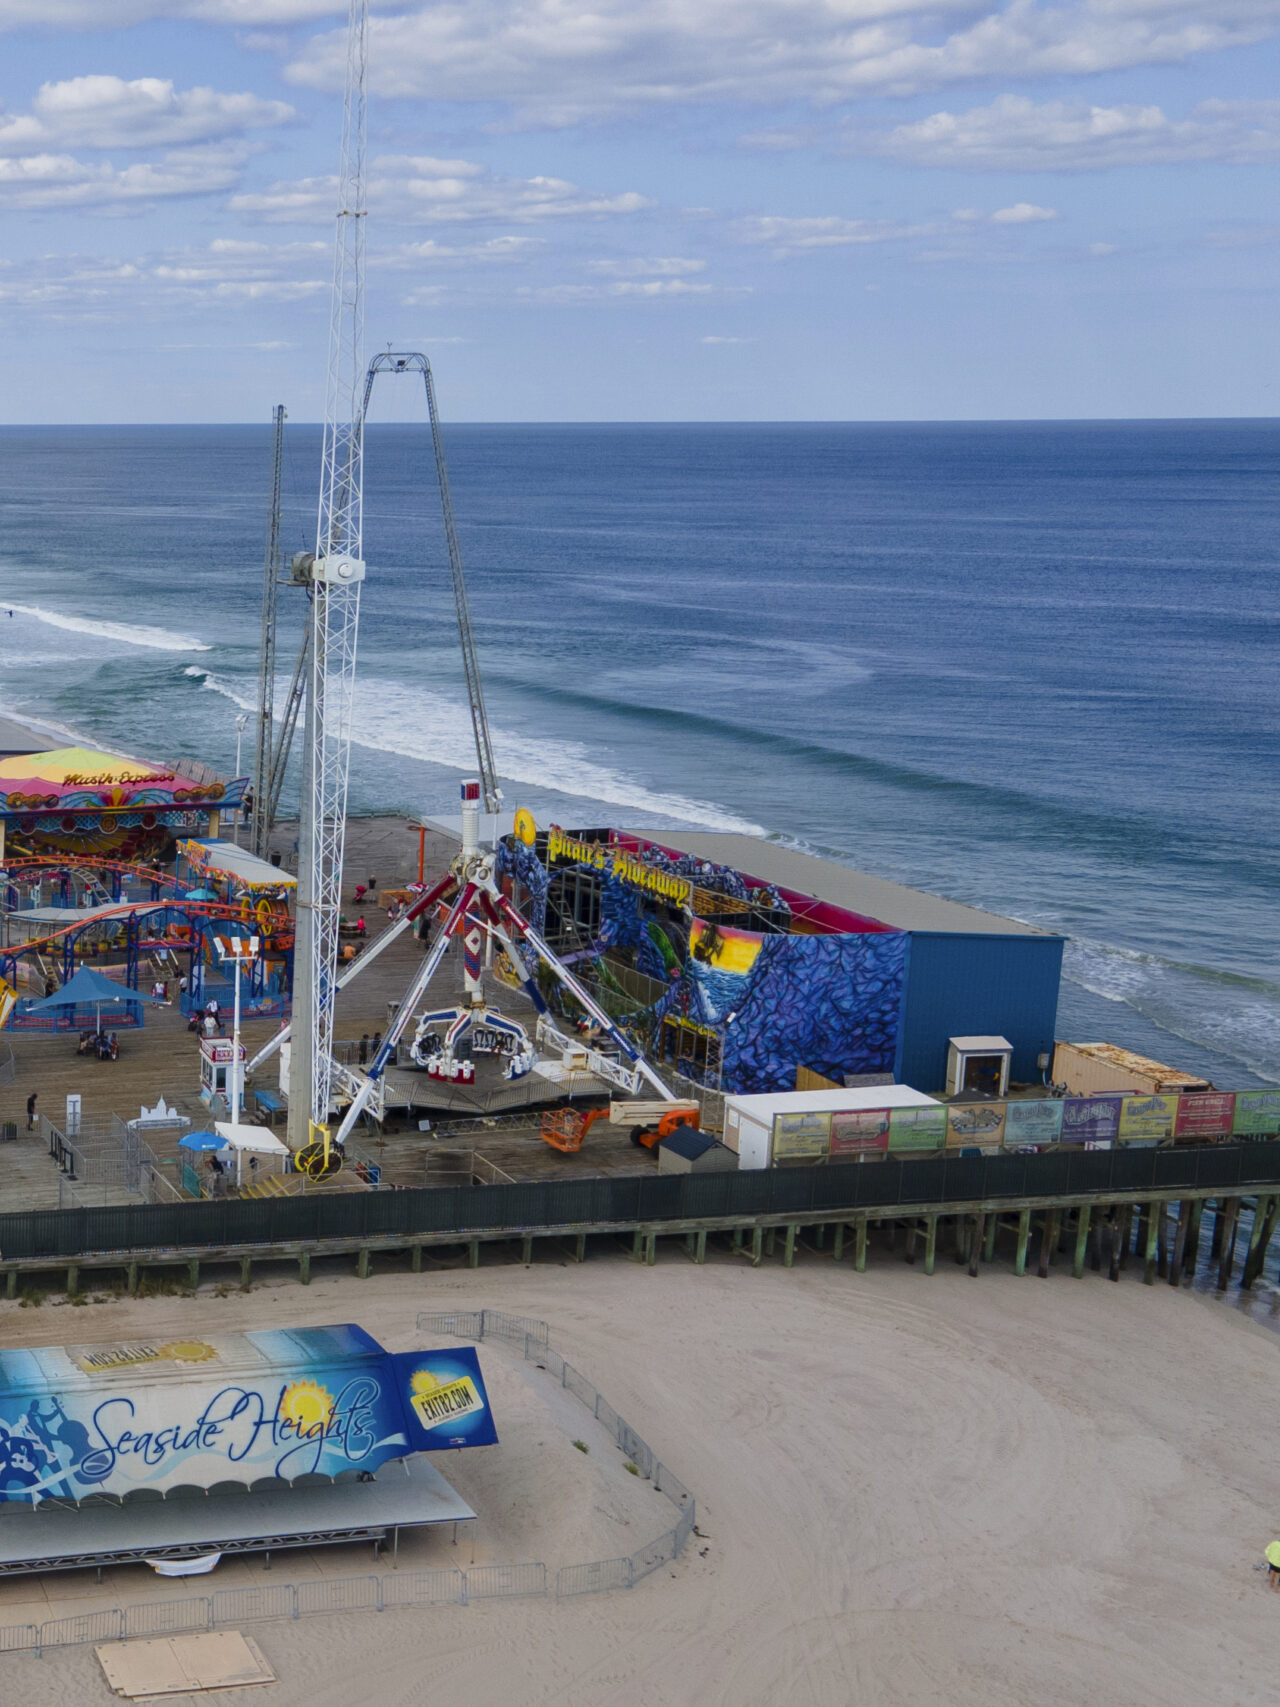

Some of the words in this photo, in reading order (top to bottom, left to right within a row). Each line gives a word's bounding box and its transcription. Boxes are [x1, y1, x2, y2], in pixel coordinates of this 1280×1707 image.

[118, 771, 176, 787] Express
[83, 1345, 161, 1367] EXIT82.COM
[420, 1385, 474, 1421] EXIT82.COM
[81, 1387, 249, 1476] Seaside
[229, 1377, 380, 1477] Heights
